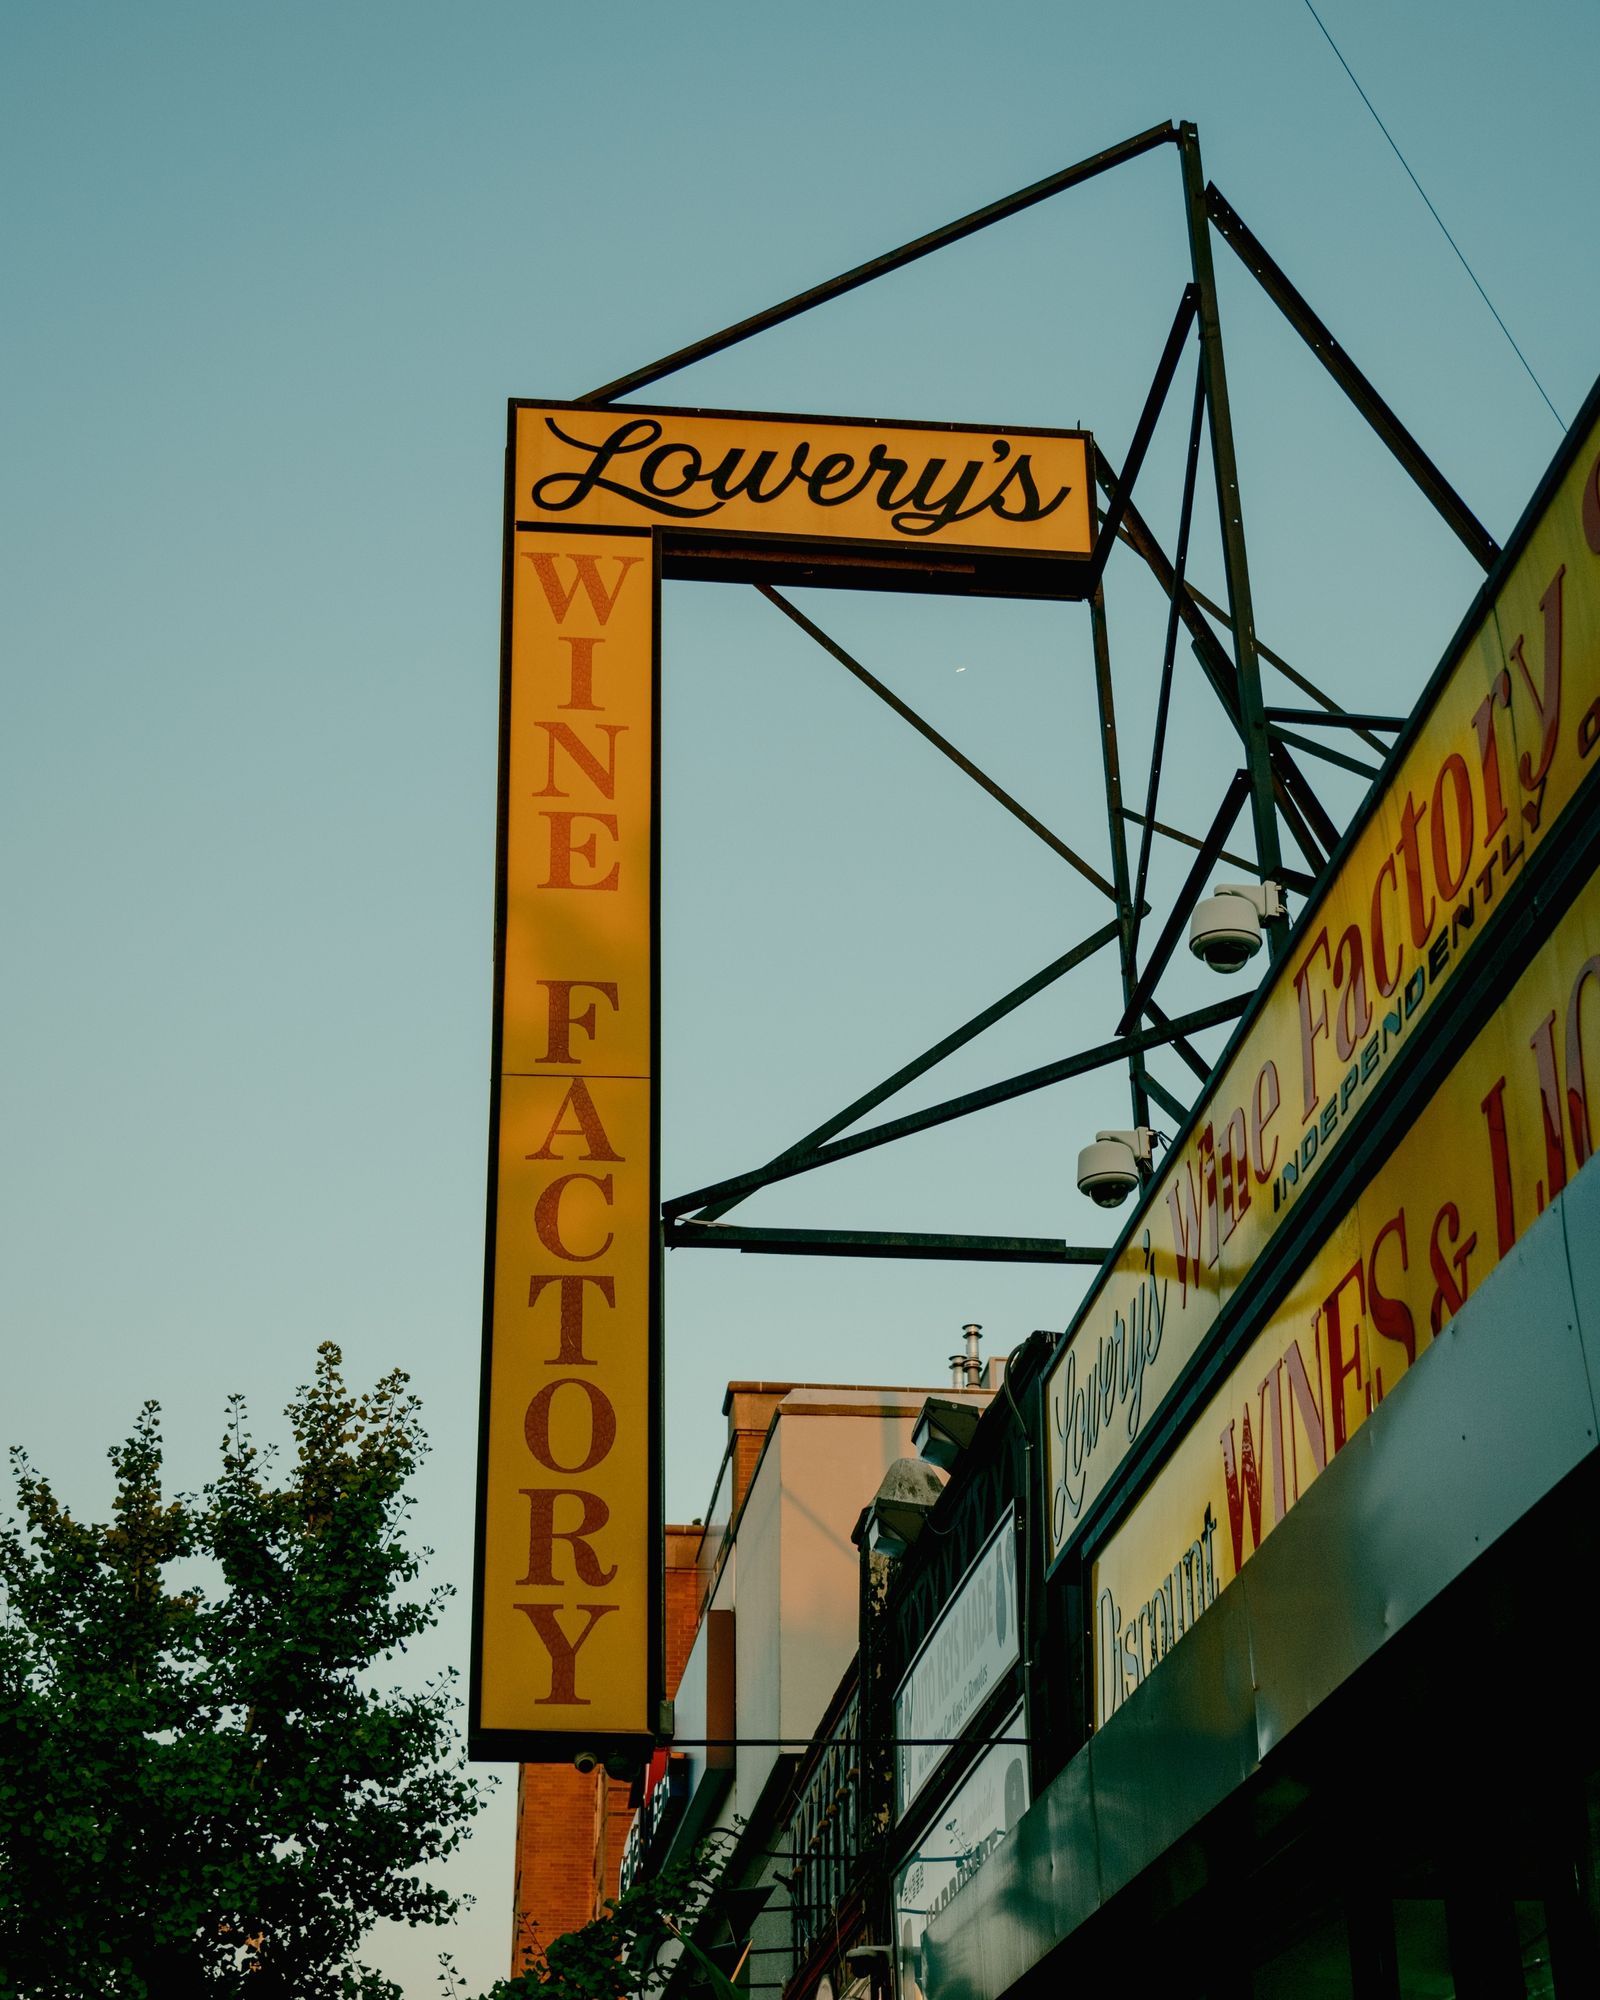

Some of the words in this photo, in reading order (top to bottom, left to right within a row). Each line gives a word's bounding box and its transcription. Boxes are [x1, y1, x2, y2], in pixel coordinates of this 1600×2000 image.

[531, 417, 1072, 537] Lowery's
[520, 551, 645, 892] WINE
[1054, 1228, 1168, 1547] Lowery's
[1166, 1059, 1281, 1310] Wine
[1292, 563, 1566, 1126] Factory
[1272, 776, 1547, 1213] INDEPENDENTLY
[512, 979, 627, 1706] FACTORY
[1096, 1501, 1220, 1733] Discount
[1219, 1206, 1417, 1576] WINES
[962, 1565, 994, 1667] MADE
